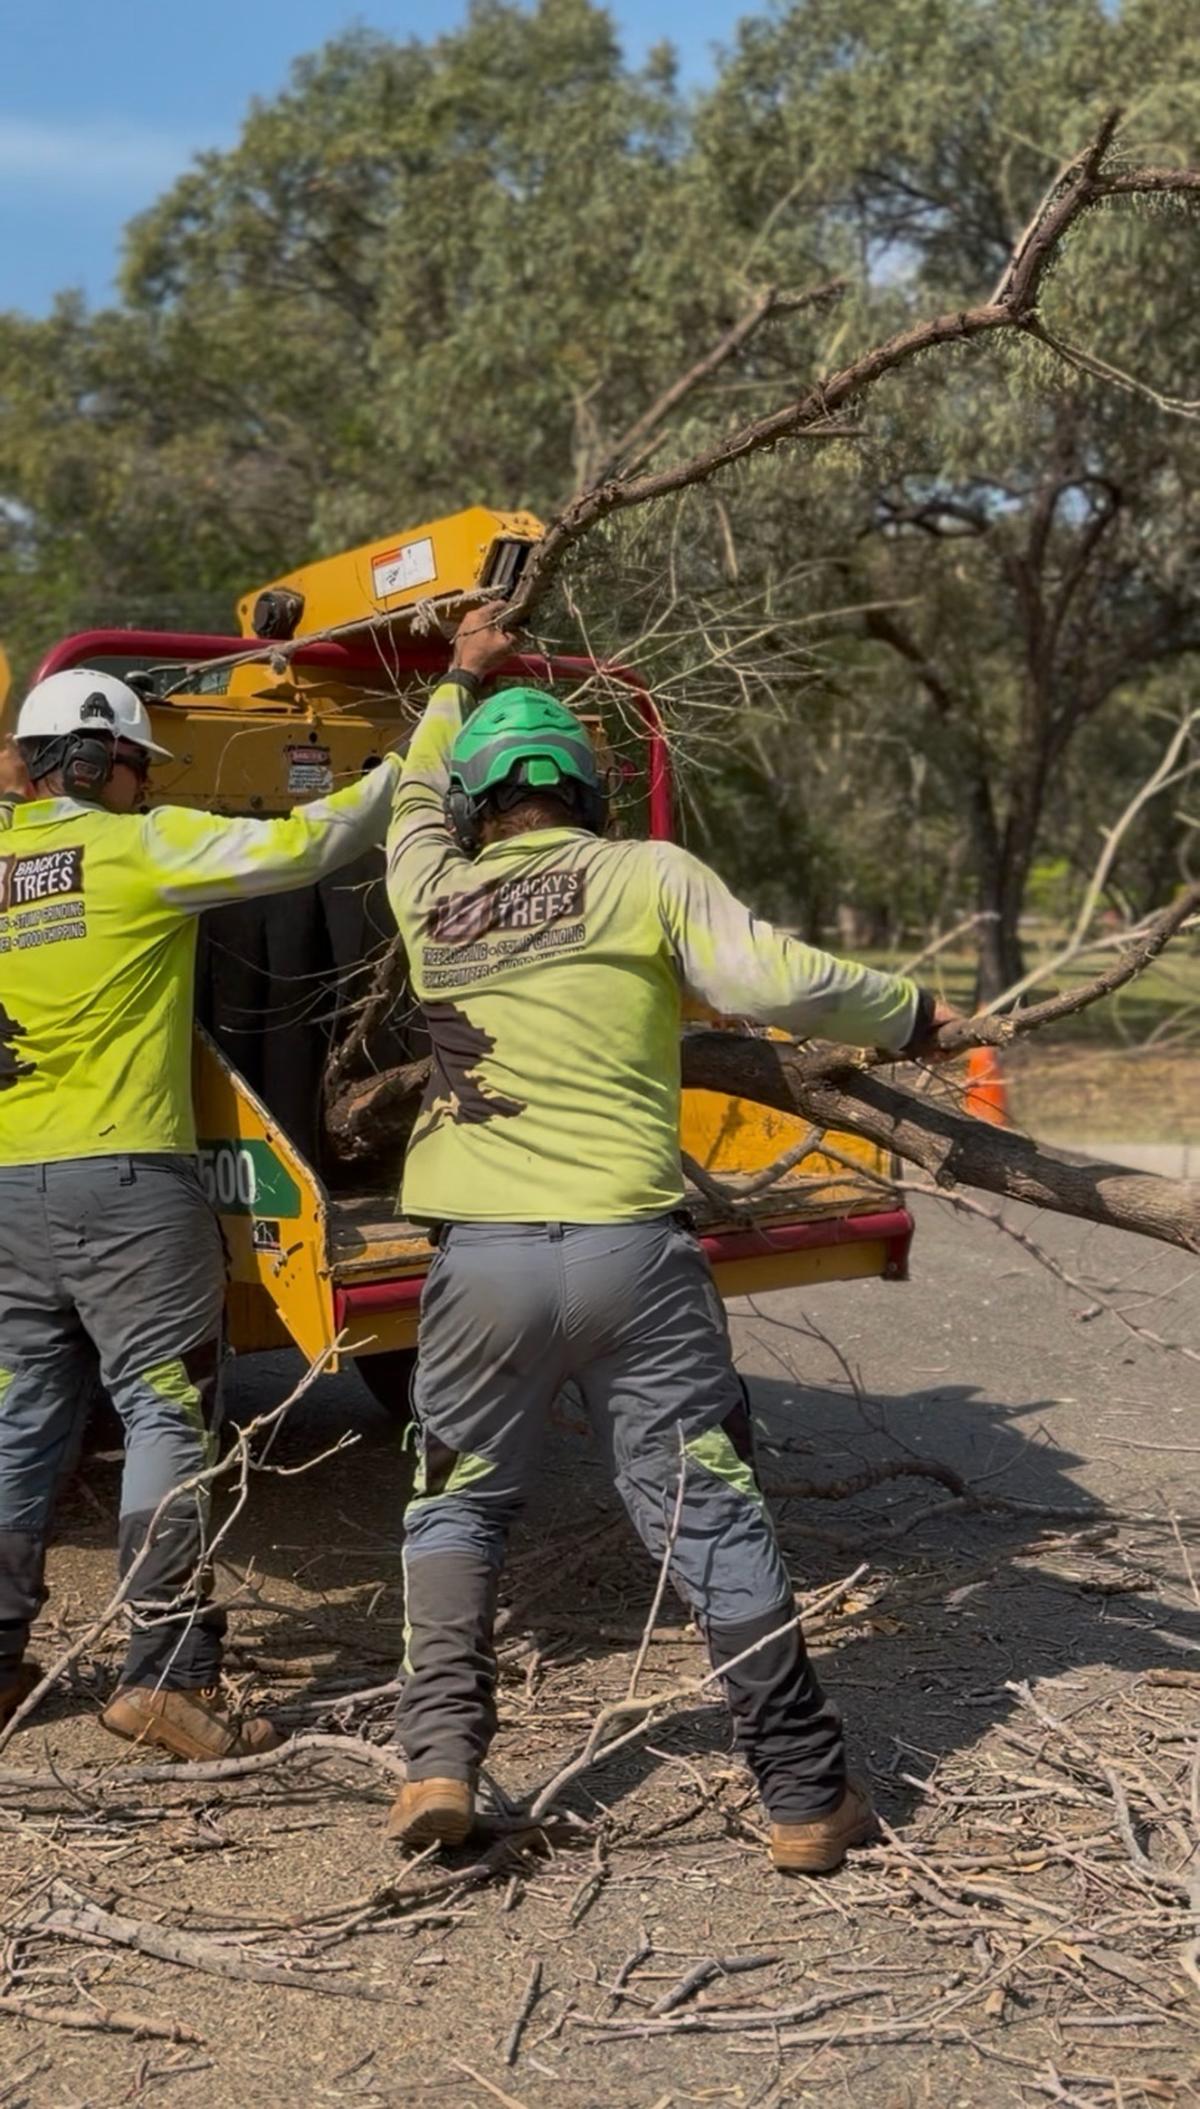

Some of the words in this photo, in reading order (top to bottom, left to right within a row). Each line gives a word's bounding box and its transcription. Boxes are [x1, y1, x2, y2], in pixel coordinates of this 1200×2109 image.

[15, 850, 77, 877] BRACKY'S
[13, 866, 74, 903] TREES
[498, 891, 575, 928] TREES
[533, 923, 586, 950] GRINDING
